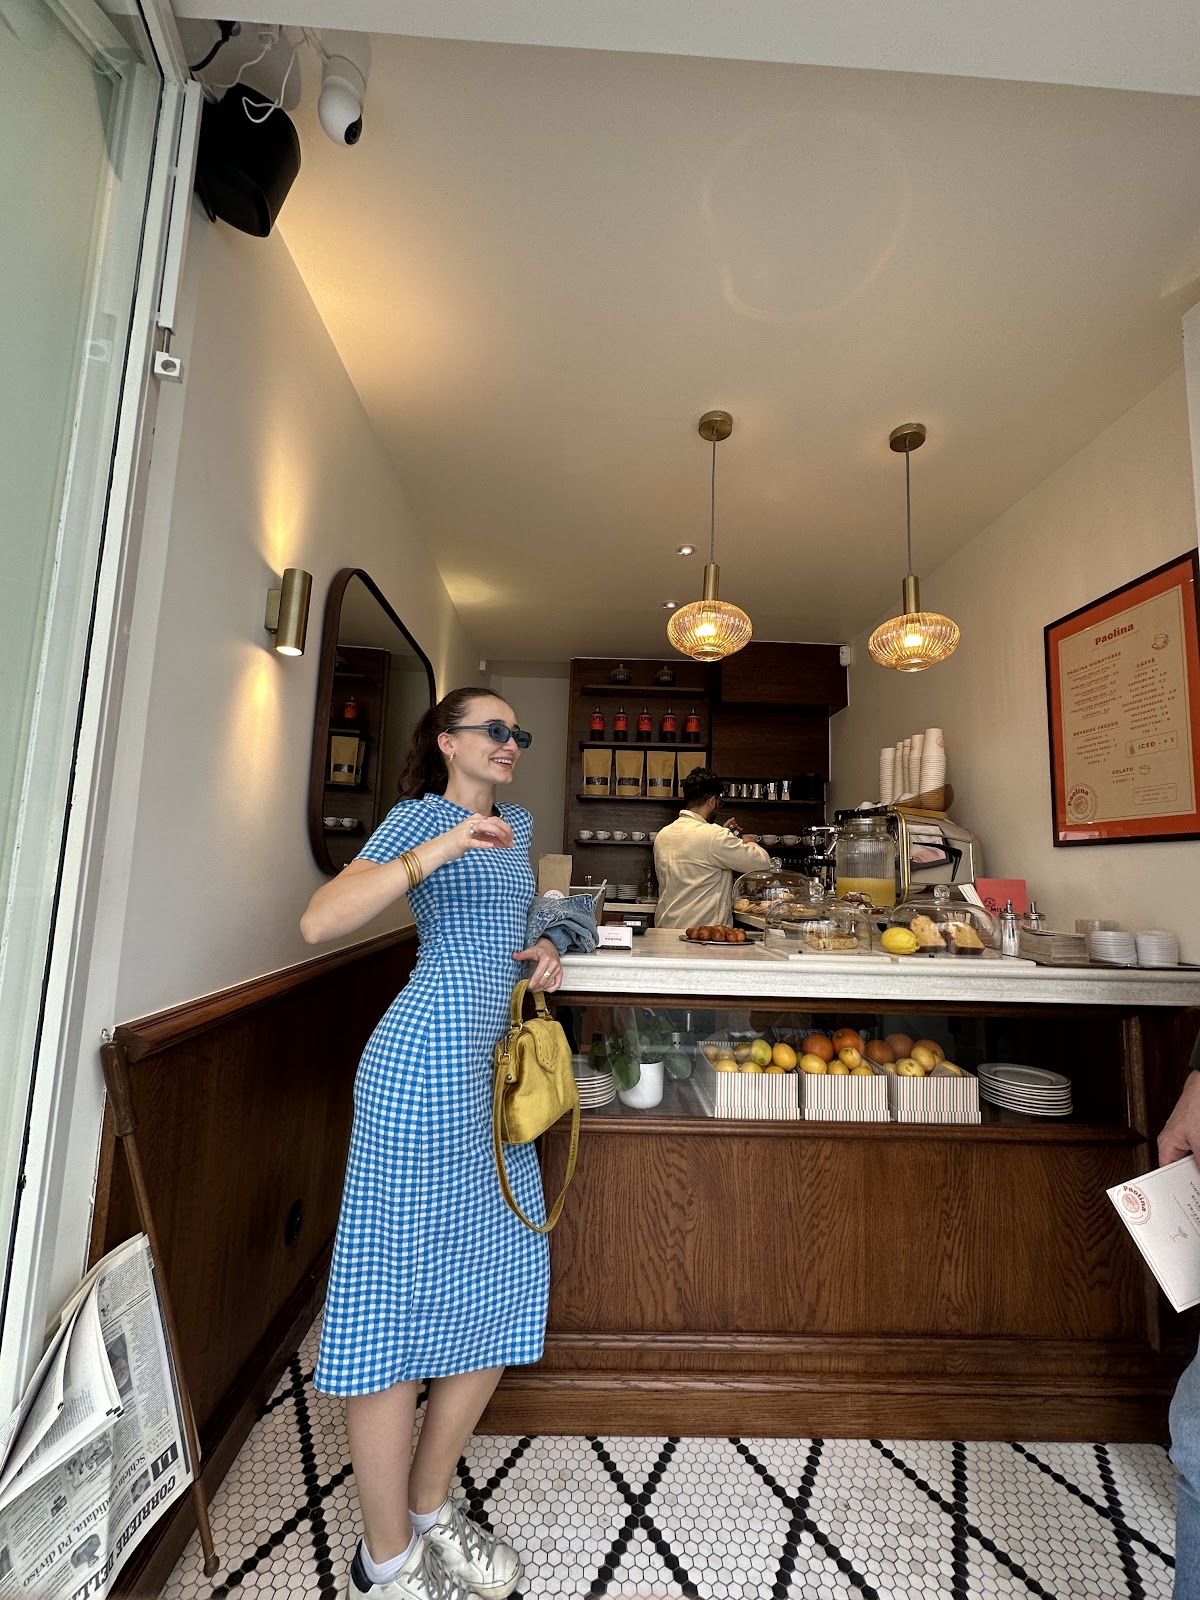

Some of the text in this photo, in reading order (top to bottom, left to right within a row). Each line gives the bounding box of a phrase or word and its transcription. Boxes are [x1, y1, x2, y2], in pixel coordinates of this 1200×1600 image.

[1094, 623, 1134, 646] Paolina
[1073, 727, 1096, 737] BEVANDE
[1138, 742, 1156, 750] ICED
[1111, 767, 1134, 775] GELATO
[1123, 1185, 1147, 1212] Paolina
[118, 1452, 146, 1487] Schlein
[116, 1475, 176, 1559] CORRIERE
[57, 1533, 73, 1555] Pd
[23, 1551, 56, 1587] diviso
[71, 1551, 115, 1600] DELL
